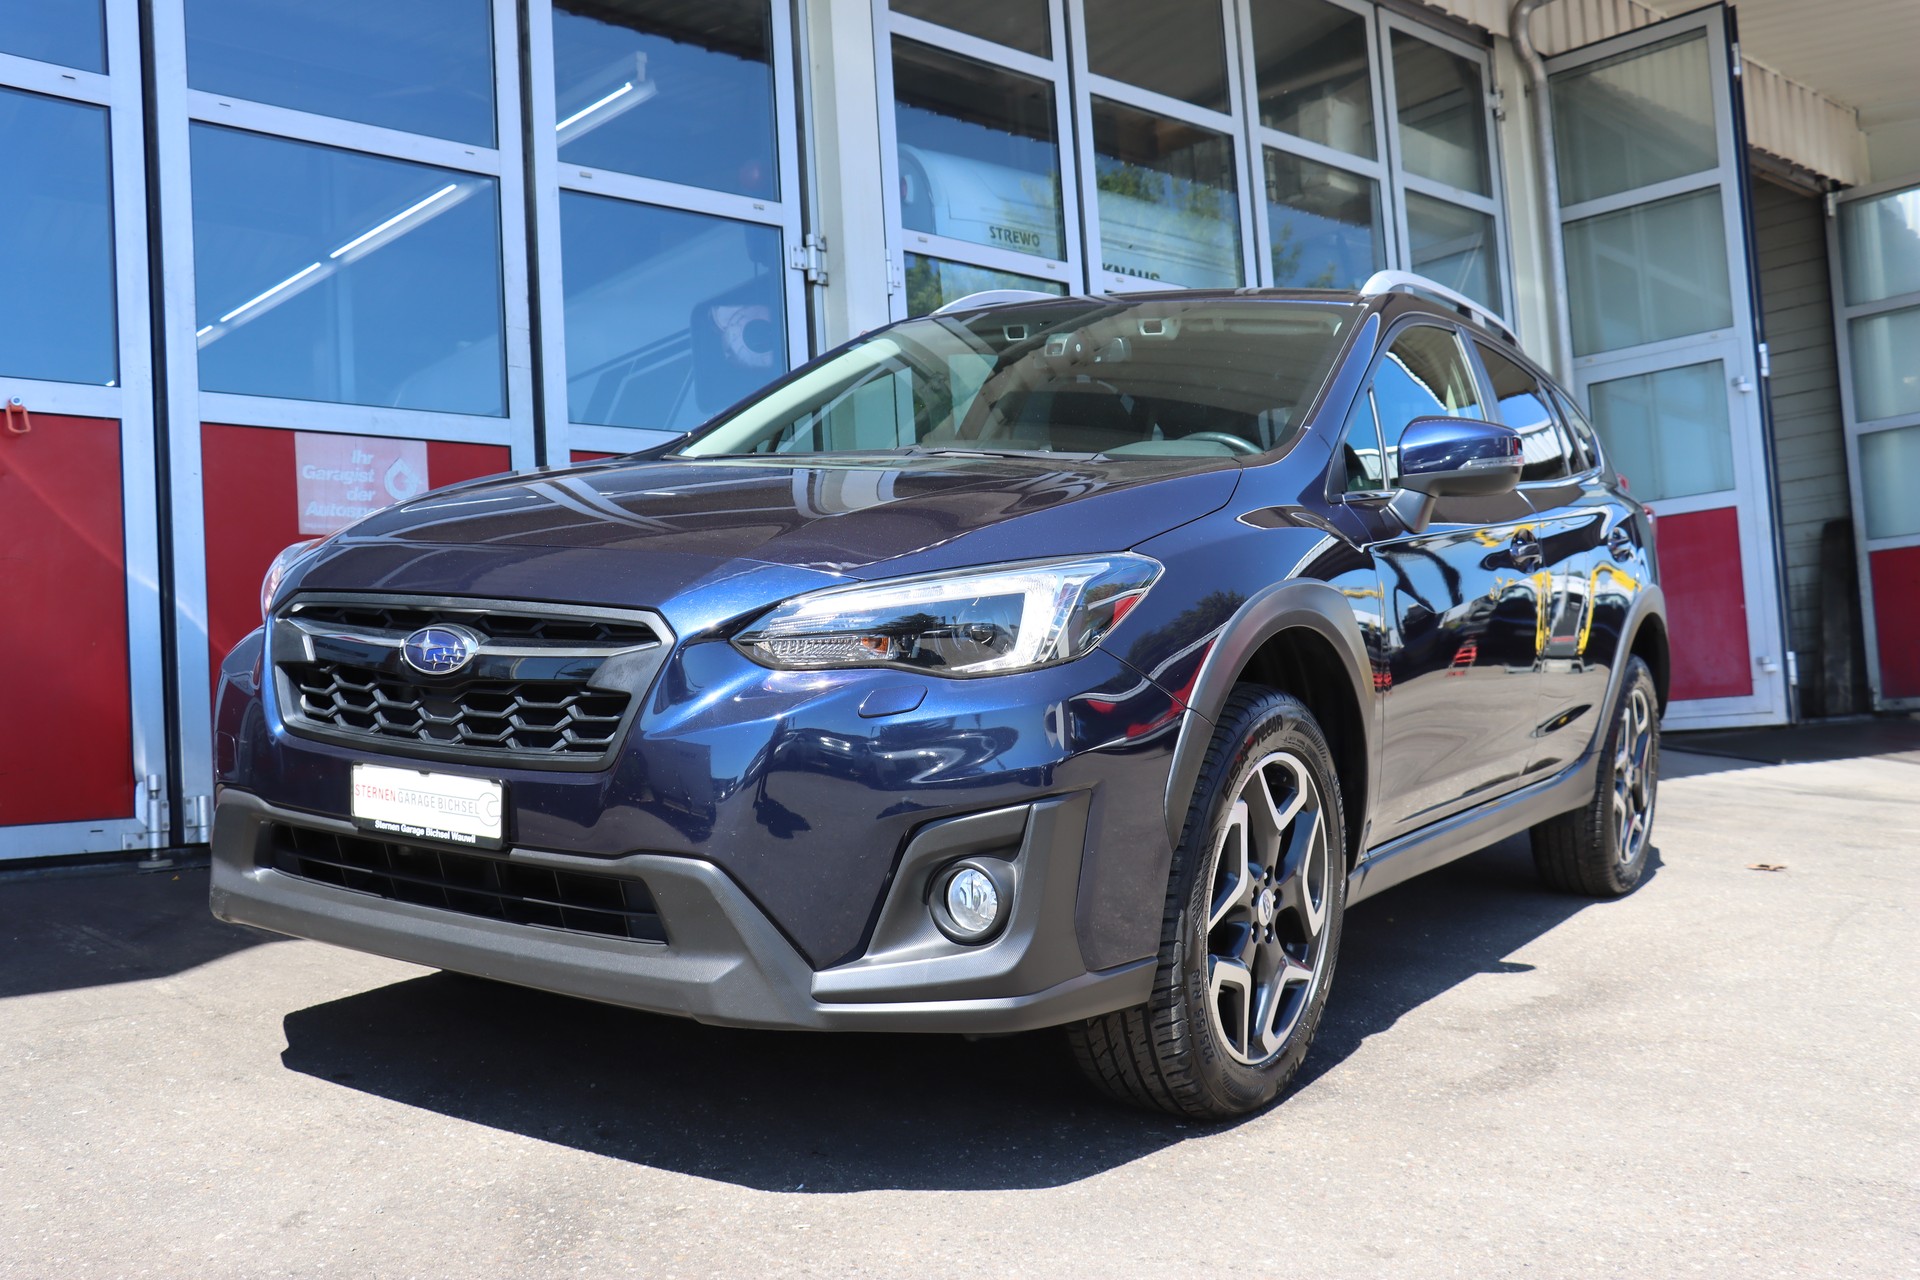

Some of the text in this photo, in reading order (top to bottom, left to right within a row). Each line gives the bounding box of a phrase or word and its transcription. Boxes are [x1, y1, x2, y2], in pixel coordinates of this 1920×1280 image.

[989, 226, 1040, 247] STREWO
[351, 449, 374, 465] Ihr
[302, 464, 375, 485] Garagist
[346, 486, 376, 502] der
[355, 783, 480, 814] STERNEN GARAGE BICHSEL
[375, 819, 400, 831] Sternen
[400, 823, 425, 836] Garage
[425, 827, 450, 839] Bichsel
